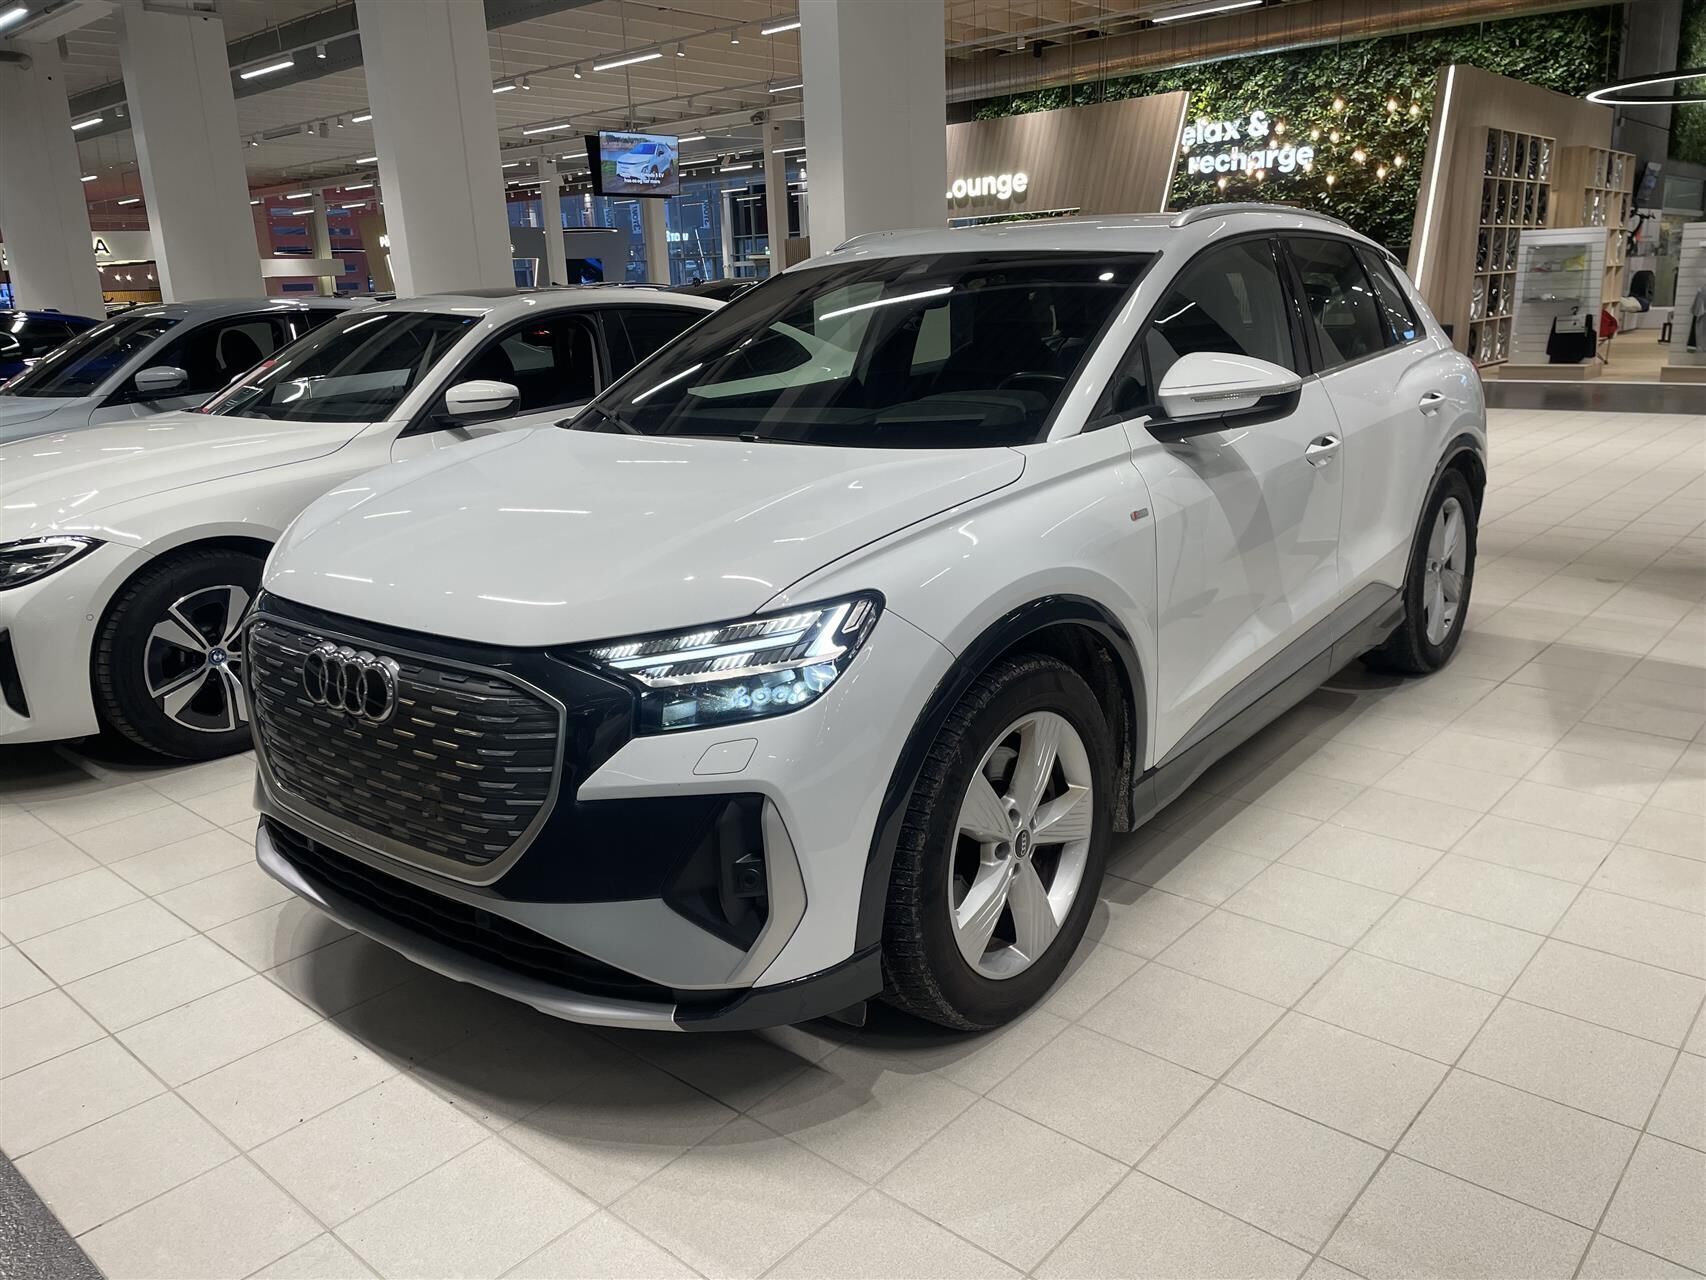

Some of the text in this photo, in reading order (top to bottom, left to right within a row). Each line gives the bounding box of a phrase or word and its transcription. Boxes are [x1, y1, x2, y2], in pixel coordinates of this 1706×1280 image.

[1181, 110, 1270, 146] elax &
[1187, 145, 1315, 175] recharge
